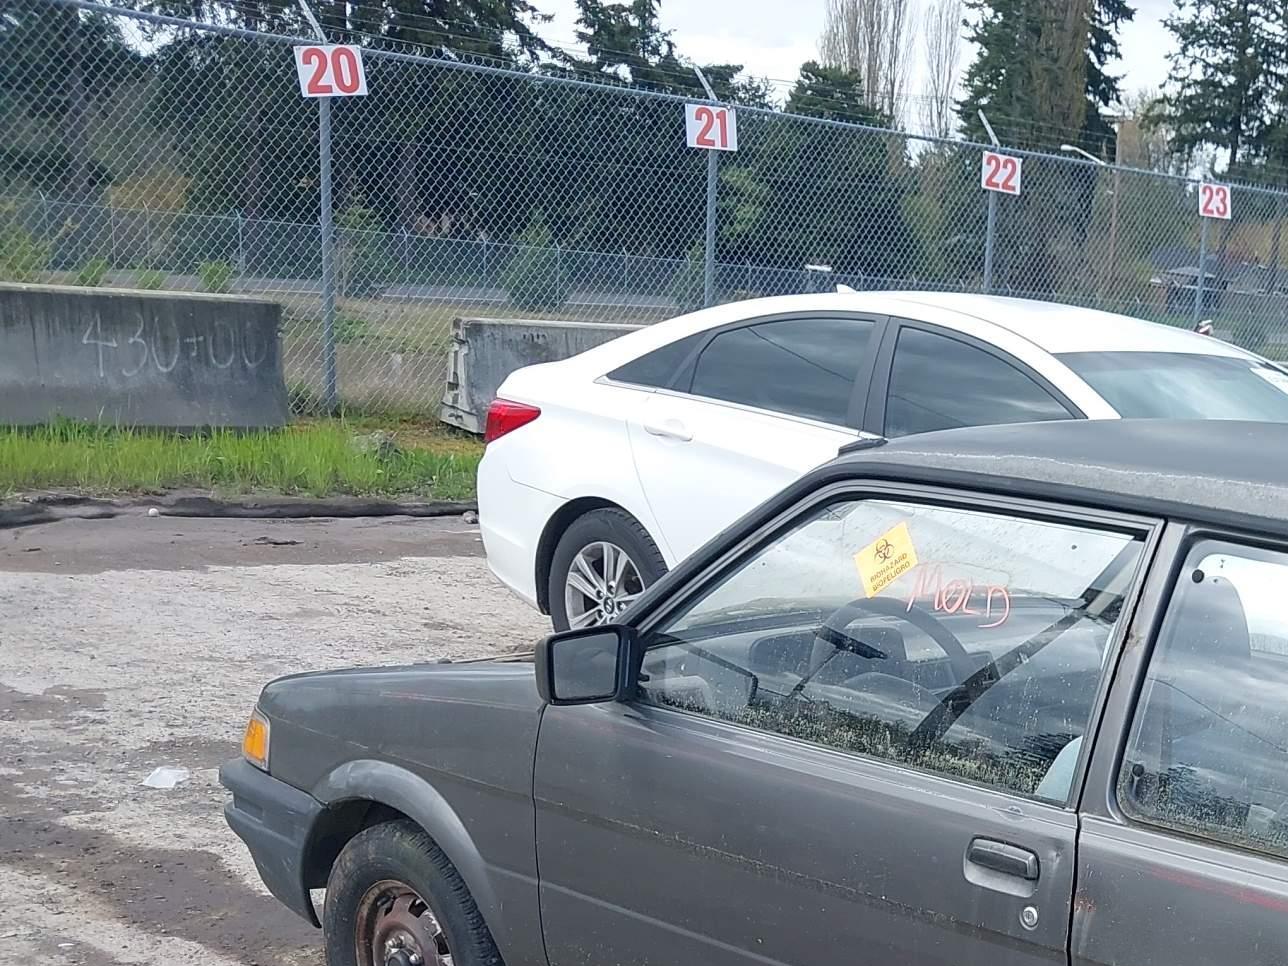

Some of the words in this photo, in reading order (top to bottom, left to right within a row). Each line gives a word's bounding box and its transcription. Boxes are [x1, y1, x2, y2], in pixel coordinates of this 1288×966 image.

[301, 46, 361, 96] 20
[694, 105, 729, 148] 21
[985, 153, 1018, 192] 22
[1202, 185, 1229, 218] 23
[869, 552, 908, 583] BIOHAZARD
[872, 560, 911, 592] BIOPELIGRO
[905, 562, 1010, 629] MOLD
